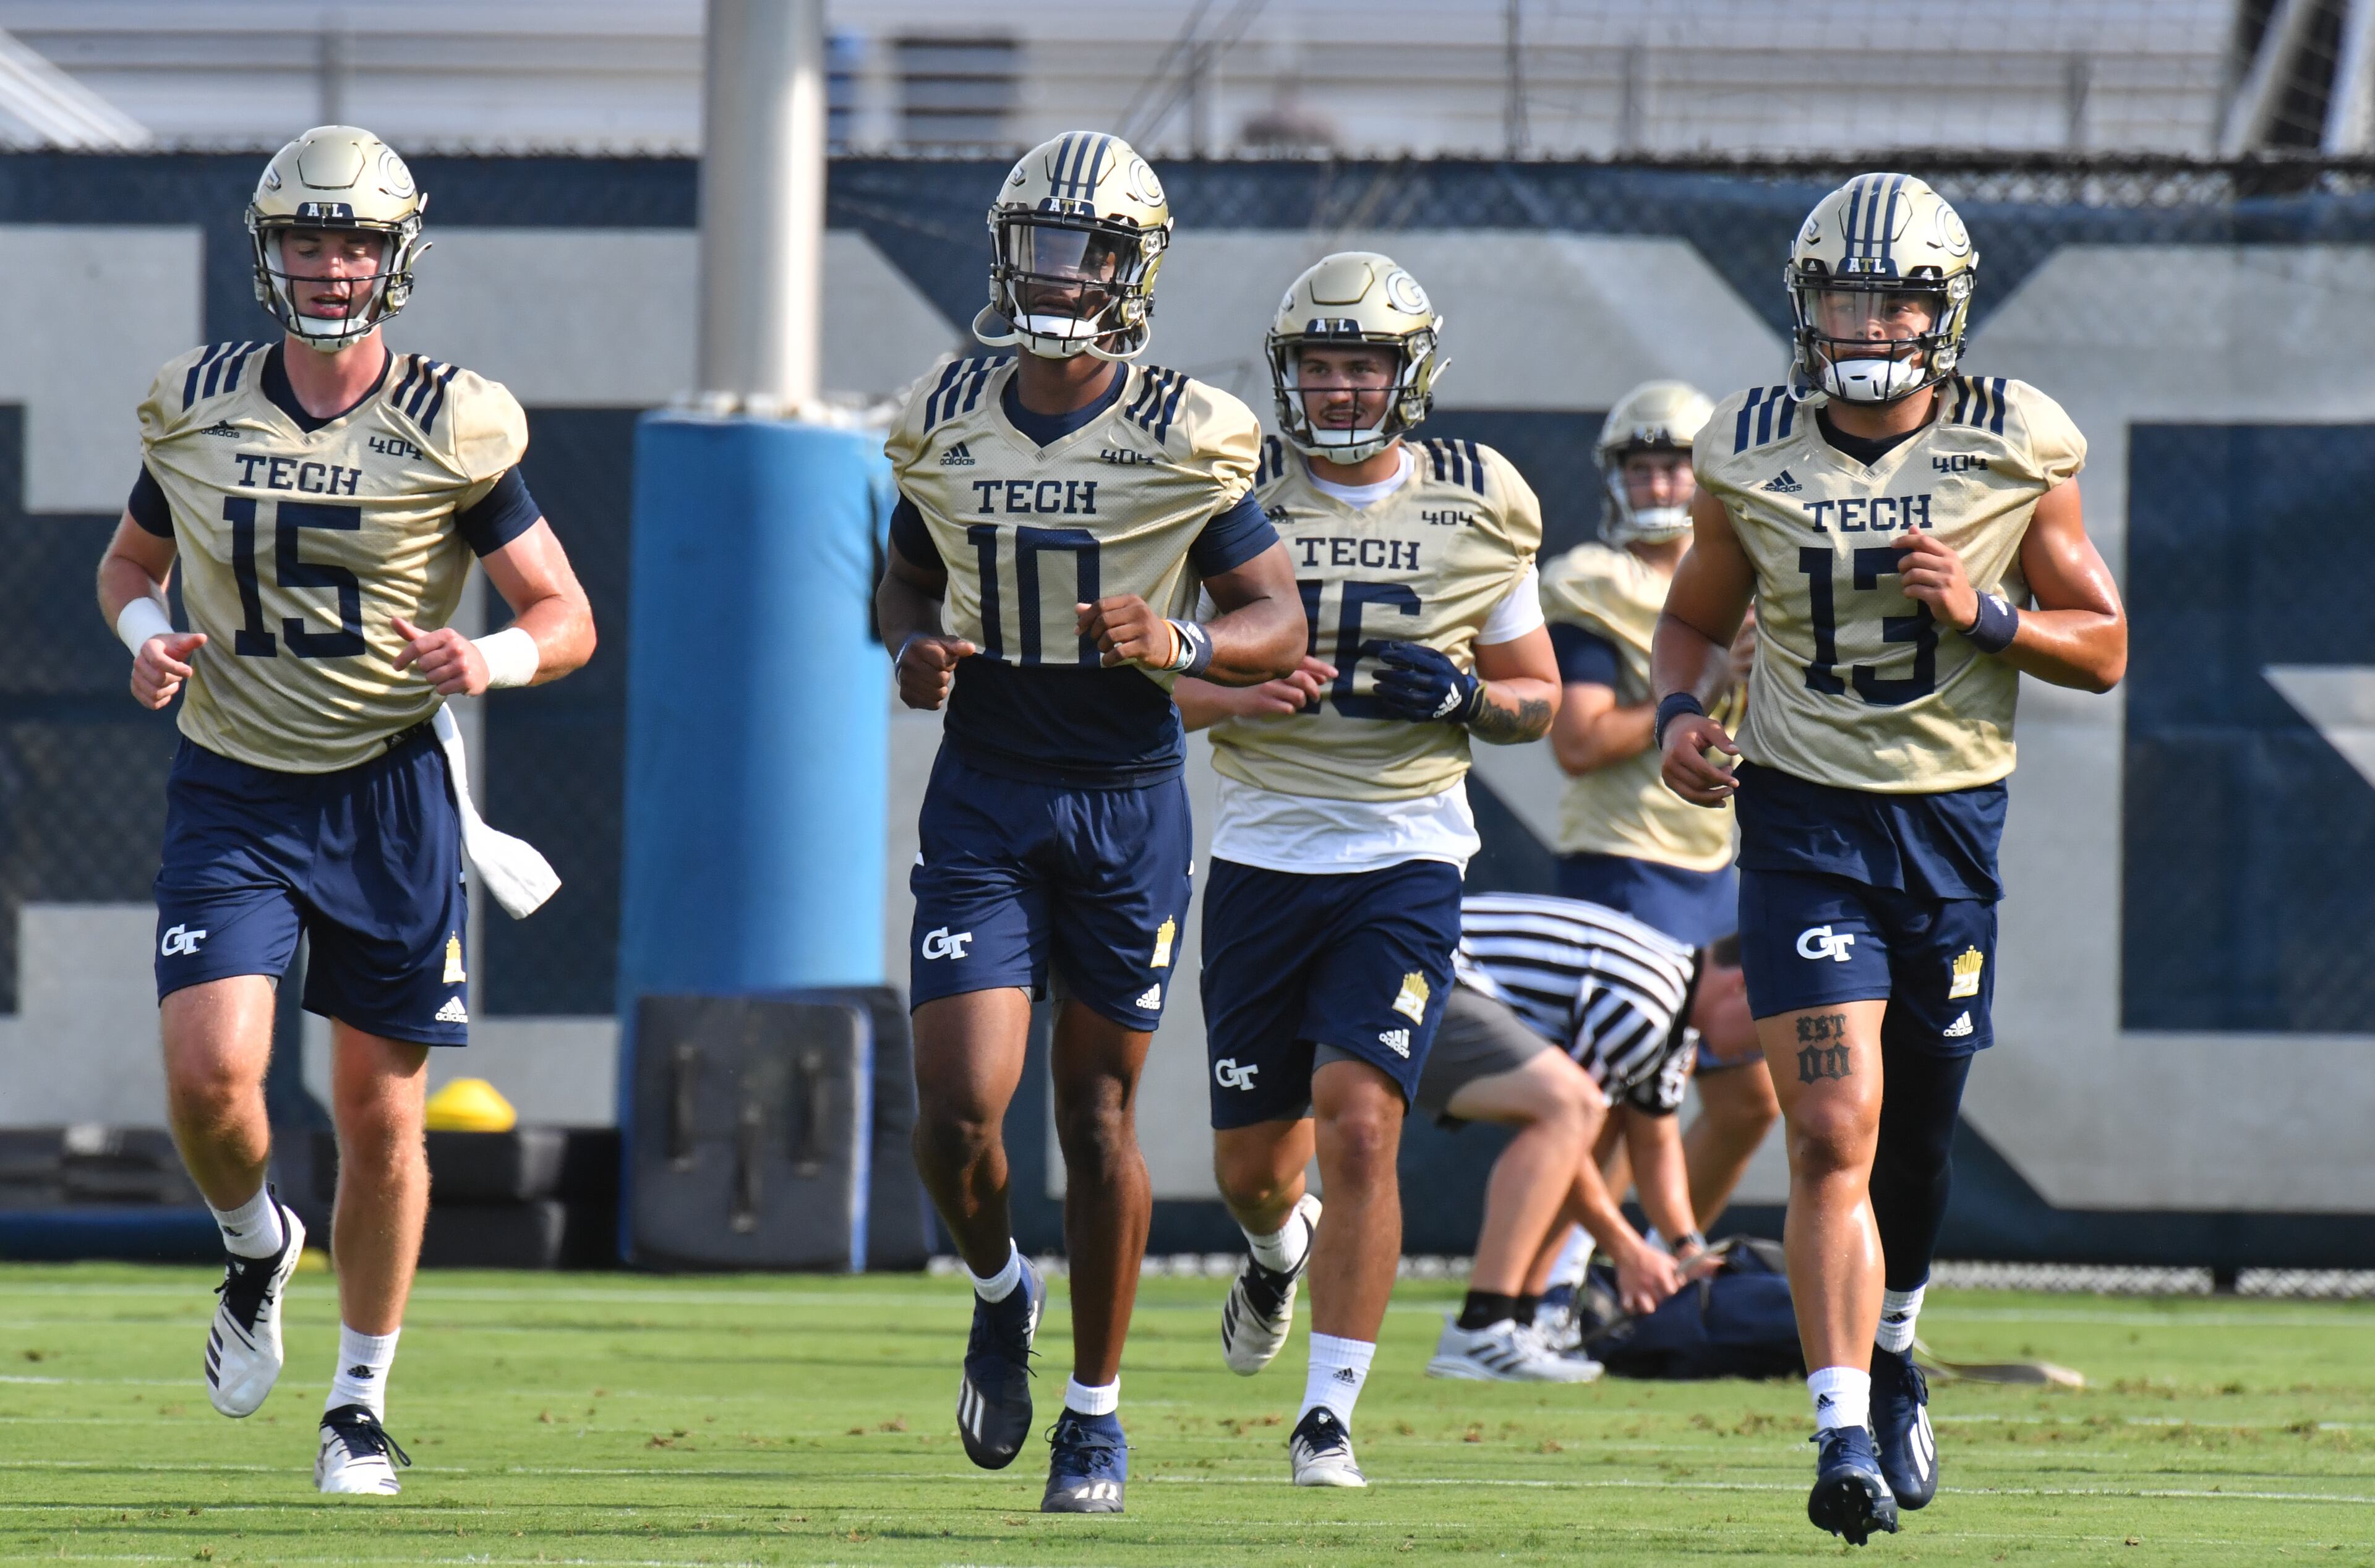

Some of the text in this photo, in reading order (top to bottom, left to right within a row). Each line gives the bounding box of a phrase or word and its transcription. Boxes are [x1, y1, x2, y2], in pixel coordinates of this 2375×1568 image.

[307, 203, 343, 217] ATL
[1049, 198, 1084, 215] ATL
[1848, 257, 1886, 273] ATL
[1315, 318, 1350, 332] ATL
[369, 436, 424, 461] 404
[939, 456, 975, 466] adidas
[1100, 449, 1155, 466] 404
[1933, 454, 1988, 473] 404
[235, 453, 362, 495] TECH
[1760, 482, 1802, 493] adidas
[973, 480, 1098, 514] TECH
[1804, 495, 1933, 532] TECH
[1422, 510, 1474, 527] 404
[1296, 537, 1421, 571] TECH
[223, 496, 366, 658] 15
[968, 525, 1100, 668] 10
[1799, 547, 1939, 705] 13
[161, 924, 206, 957] GT
[922, 927, 972, 960] GT
[1797, 926, 1854, 962] GT
[1215, 1057, 1259, 1091] GT
